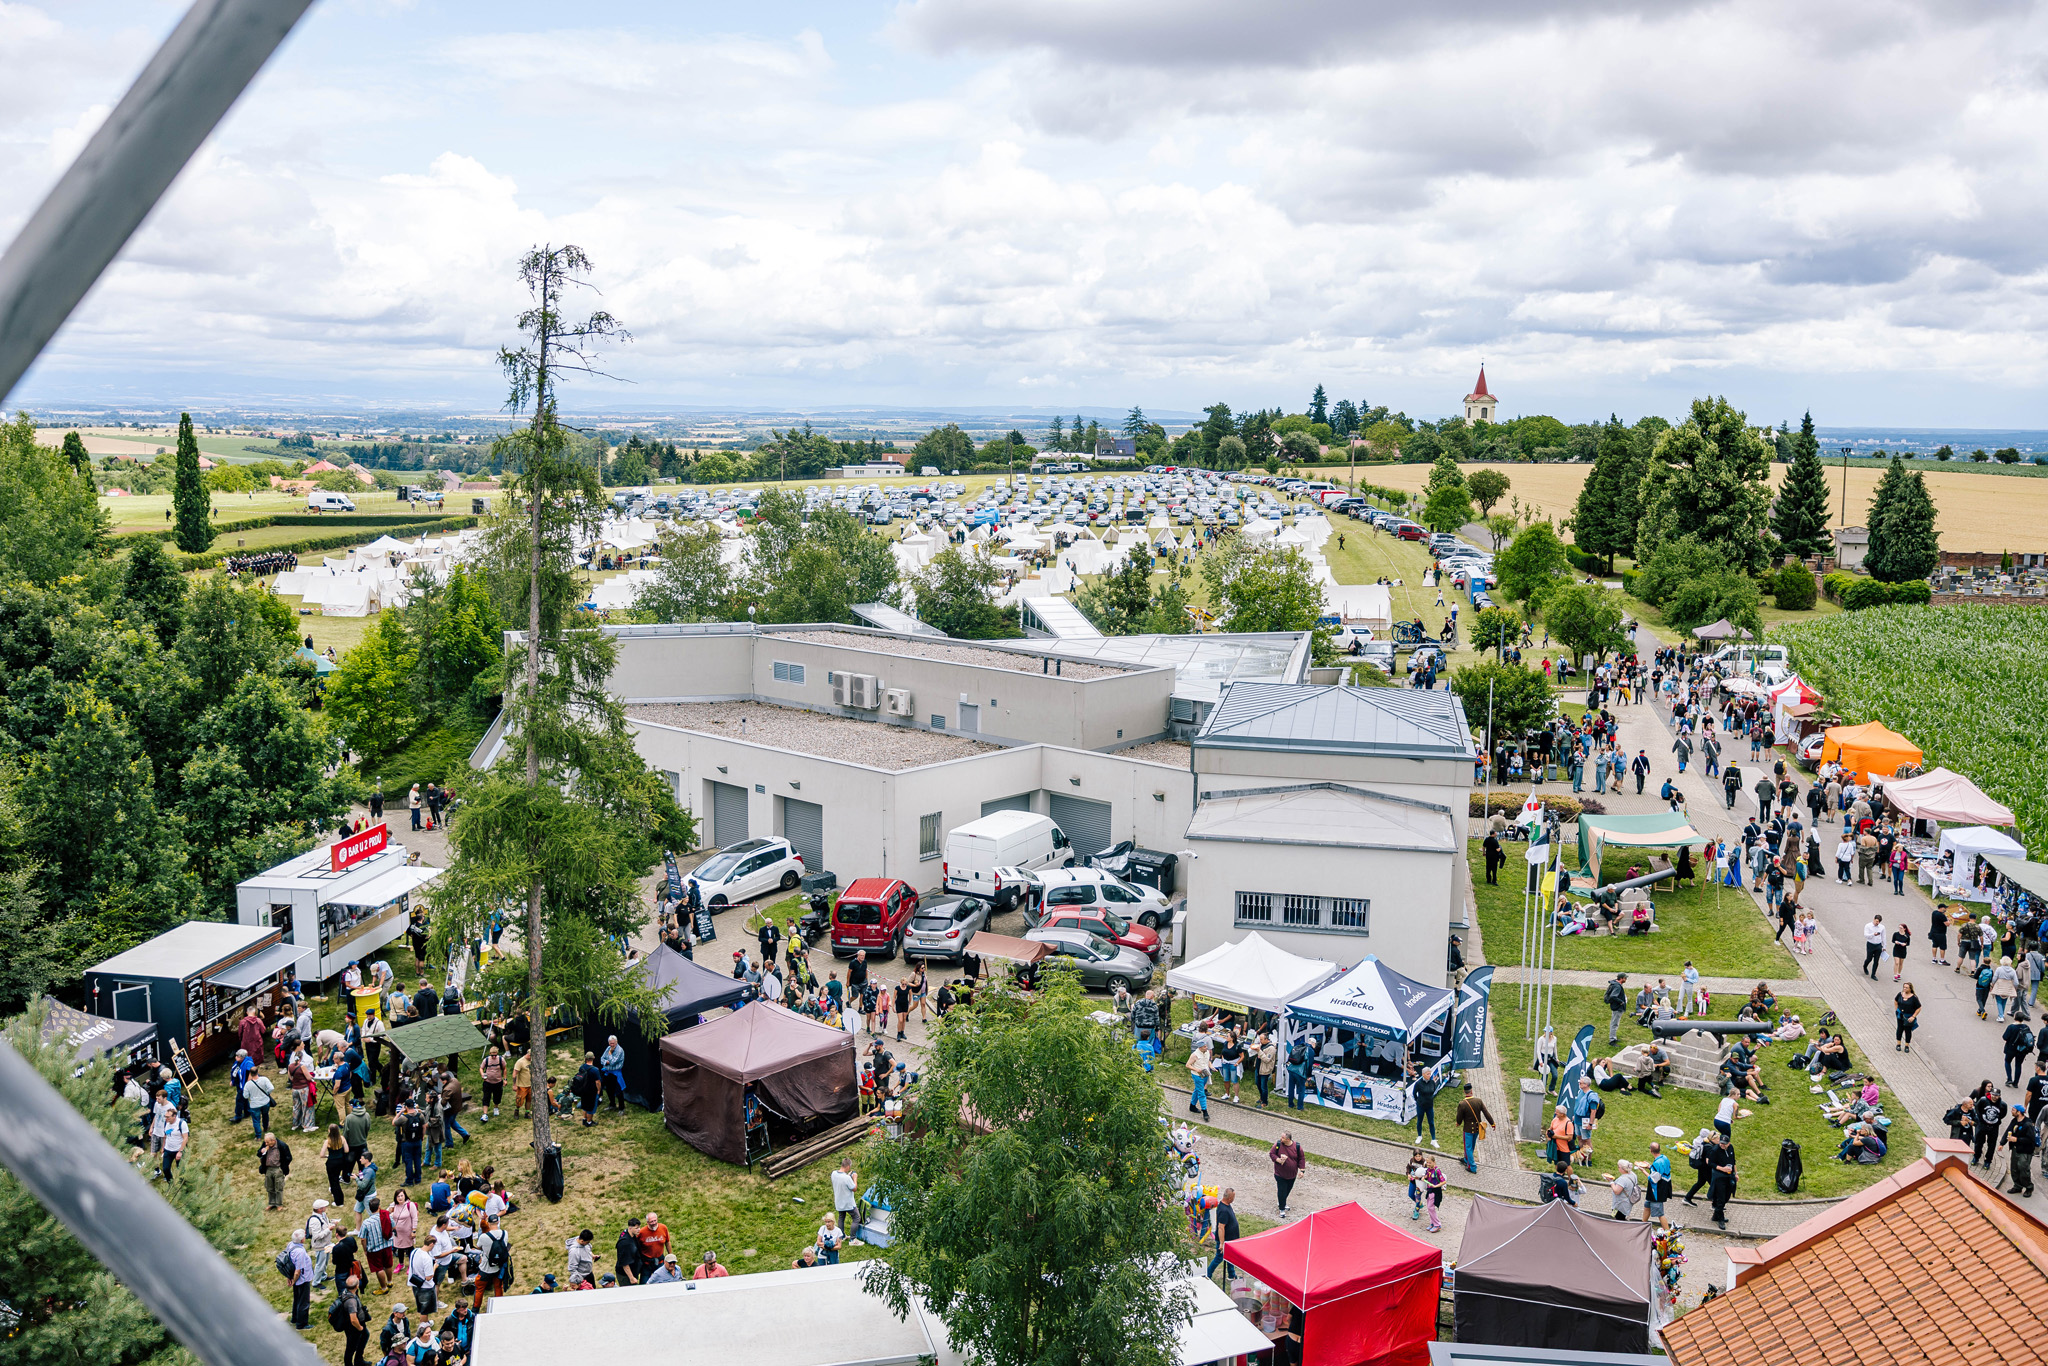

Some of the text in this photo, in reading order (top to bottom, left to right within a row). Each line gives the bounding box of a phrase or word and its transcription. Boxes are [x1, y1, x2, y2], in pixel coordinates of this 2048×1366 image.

[348, 843, 359, 857] BAR
[360, 842, 364, 852] U
[364, 839, 368, 850] 2
[1330, 997, 1374, 1012] Hradecko
[1404, 990, 1427, 1008] Hradecko
[1341, 1020, 1360, 1028] POZNEJ
[1361, 1024, 1390, 1035] HRADECKO!
[1473, 1006, 1485, 1055] Hradecko
[1377, 1101, 1401, 1111] Hradecko
